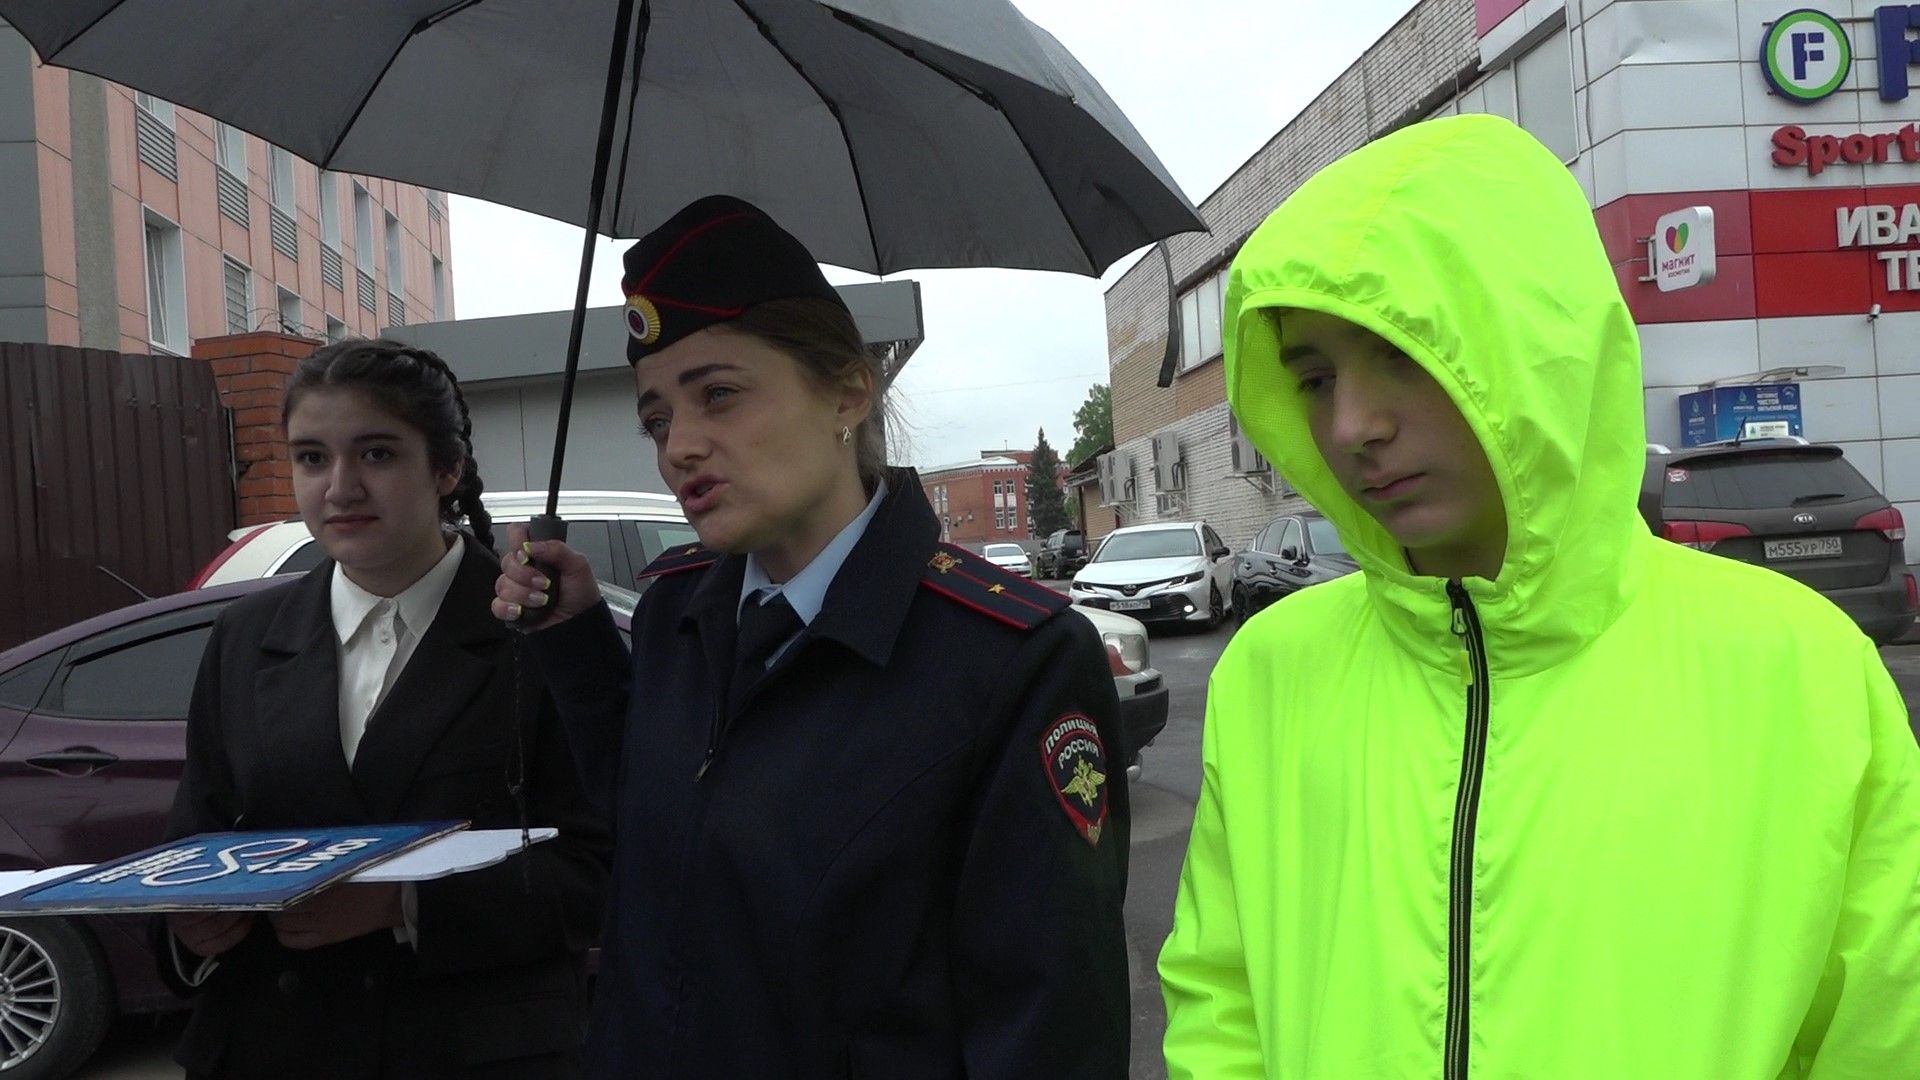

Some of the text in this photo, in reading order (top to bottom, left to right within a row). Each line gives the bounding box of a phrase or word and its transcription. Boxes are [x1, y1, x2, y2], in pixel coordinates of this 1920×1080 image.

[1791, 32, 1825, 81] F
[1836, 203, 1920, 248] ИВА
[1045, 718, 1099, 755] ПОЛИЦИЯ
[1057, 738, 1099, 770] РОССИЯ
